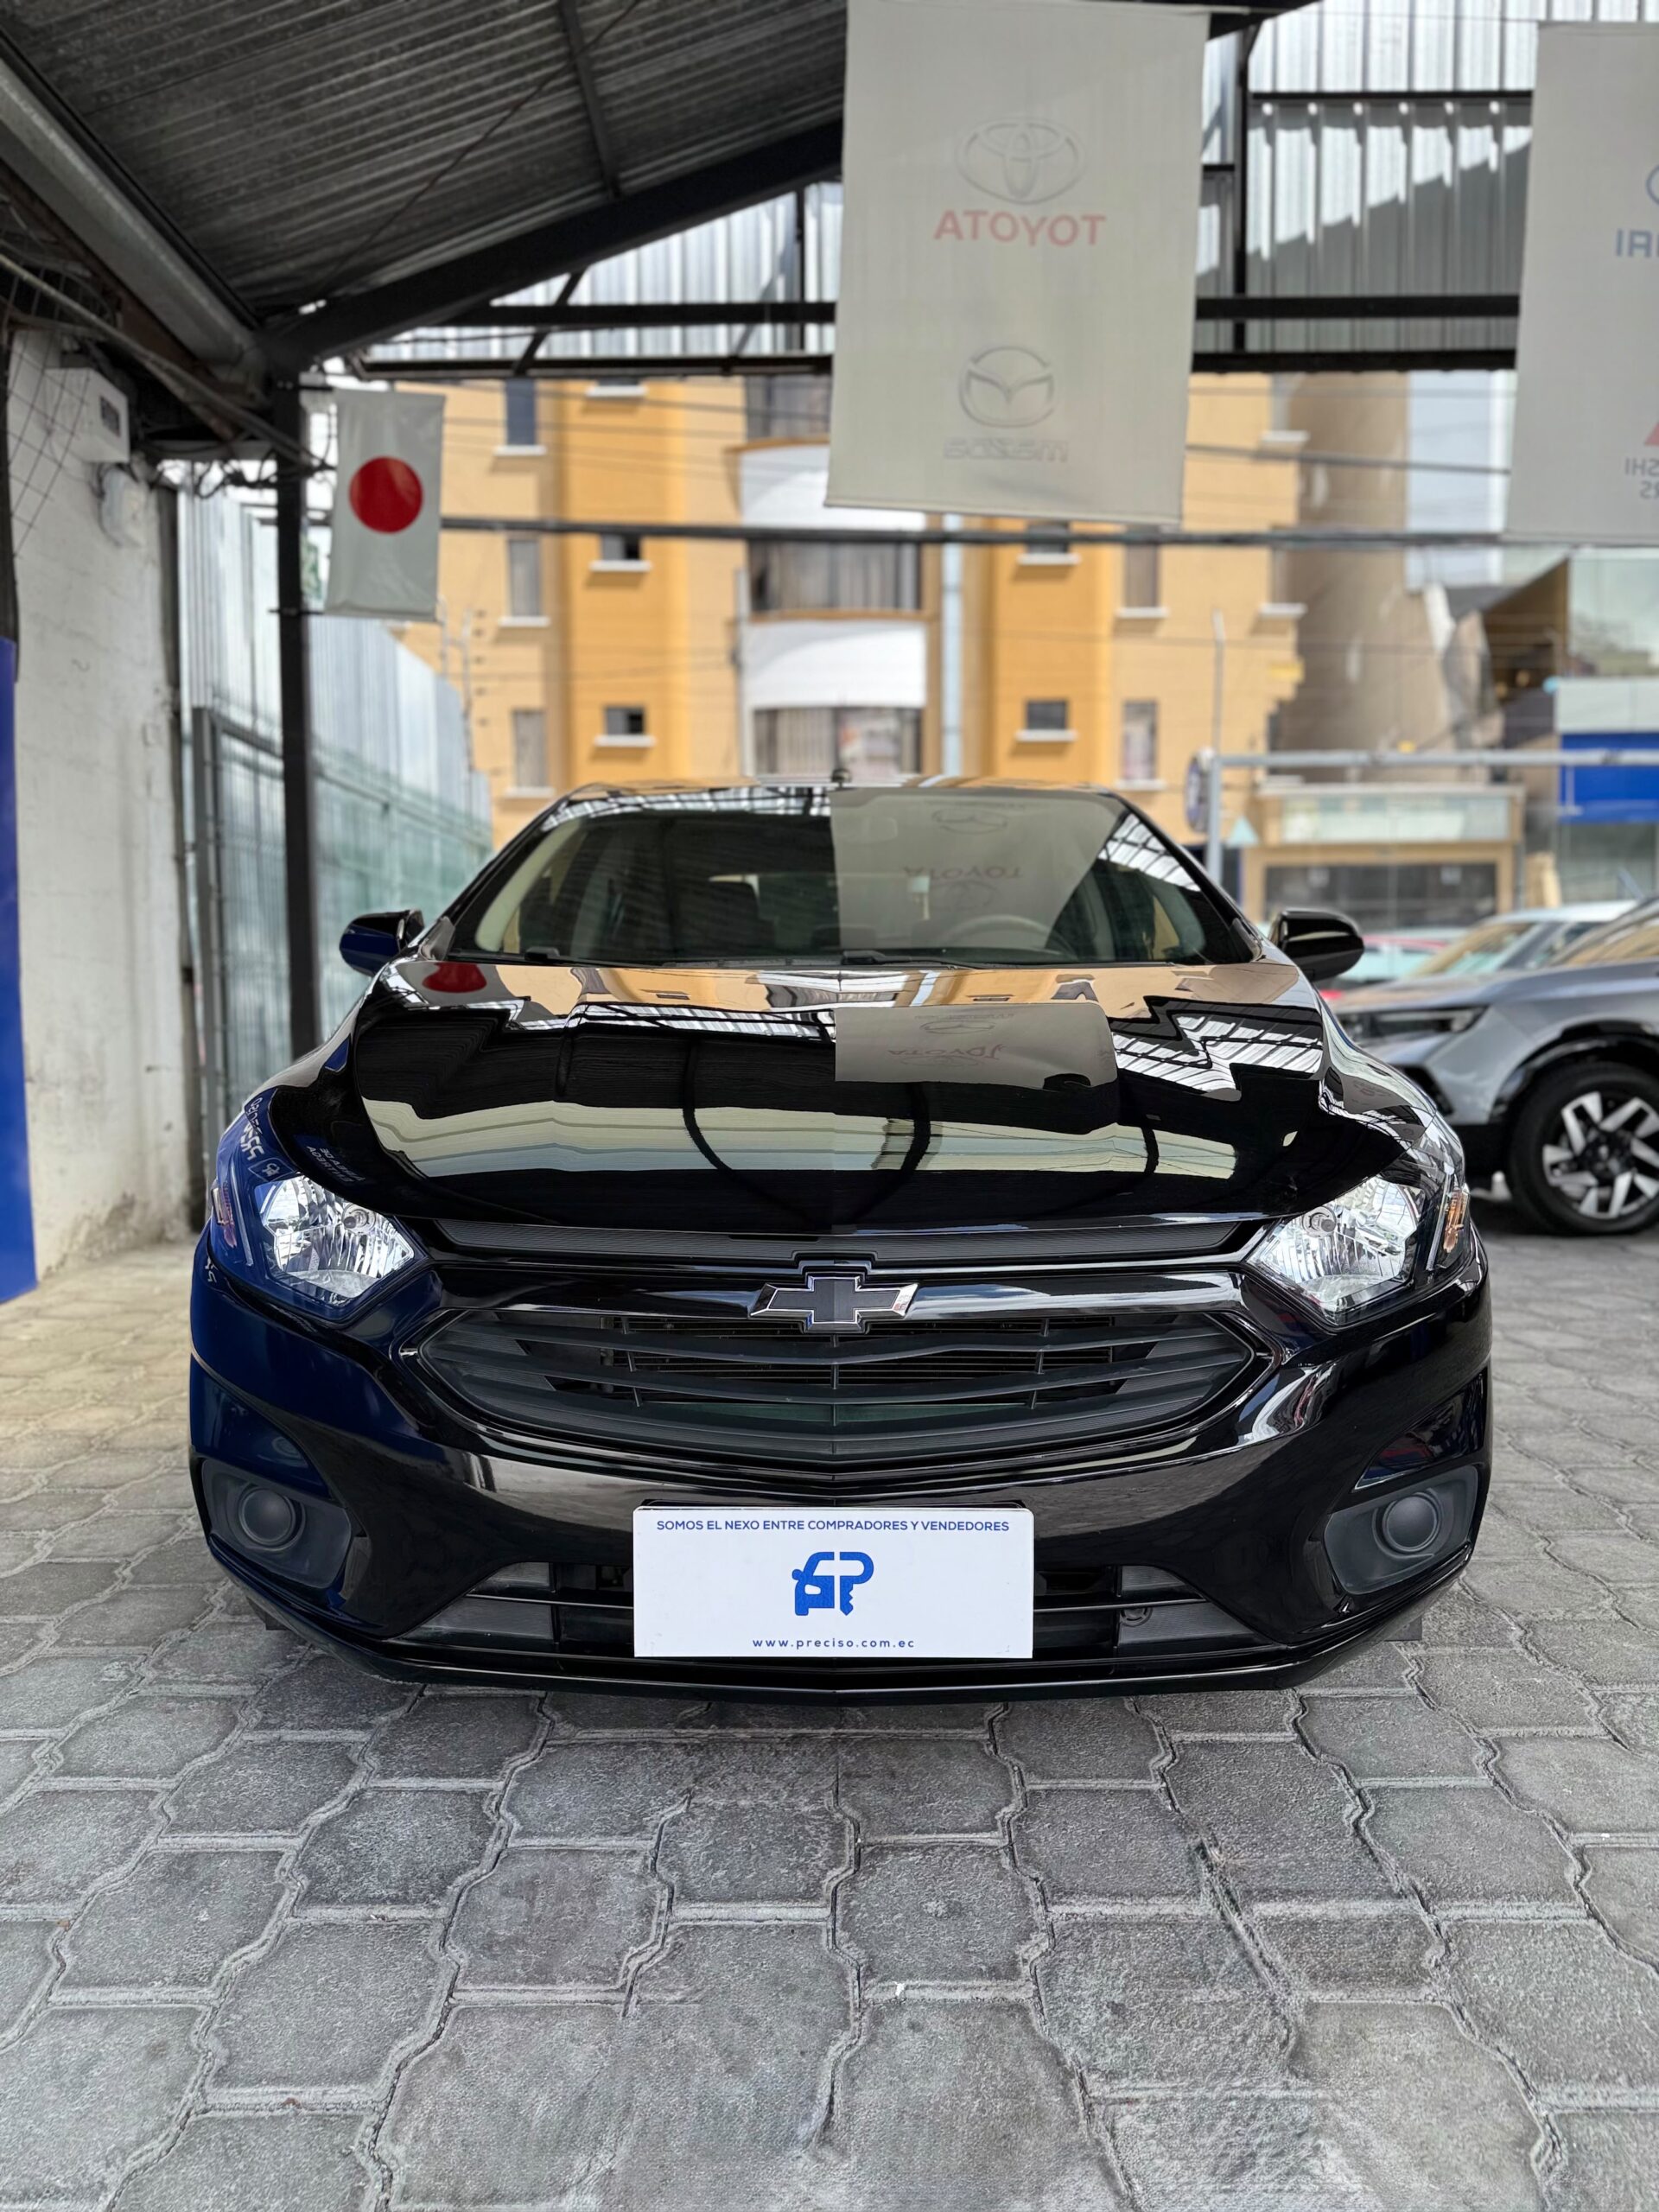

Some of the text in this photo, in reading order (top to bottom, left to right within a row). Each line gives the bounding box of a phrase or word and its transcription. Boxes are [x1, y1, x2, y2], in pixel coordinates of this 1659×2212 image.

[657, 1520, 1010, 1532] SOMOS EL NEXO ENTRE COMPRADORES Y VENDEDORES
[752, 1637, 915, 1650] www.preciso.com.ec
